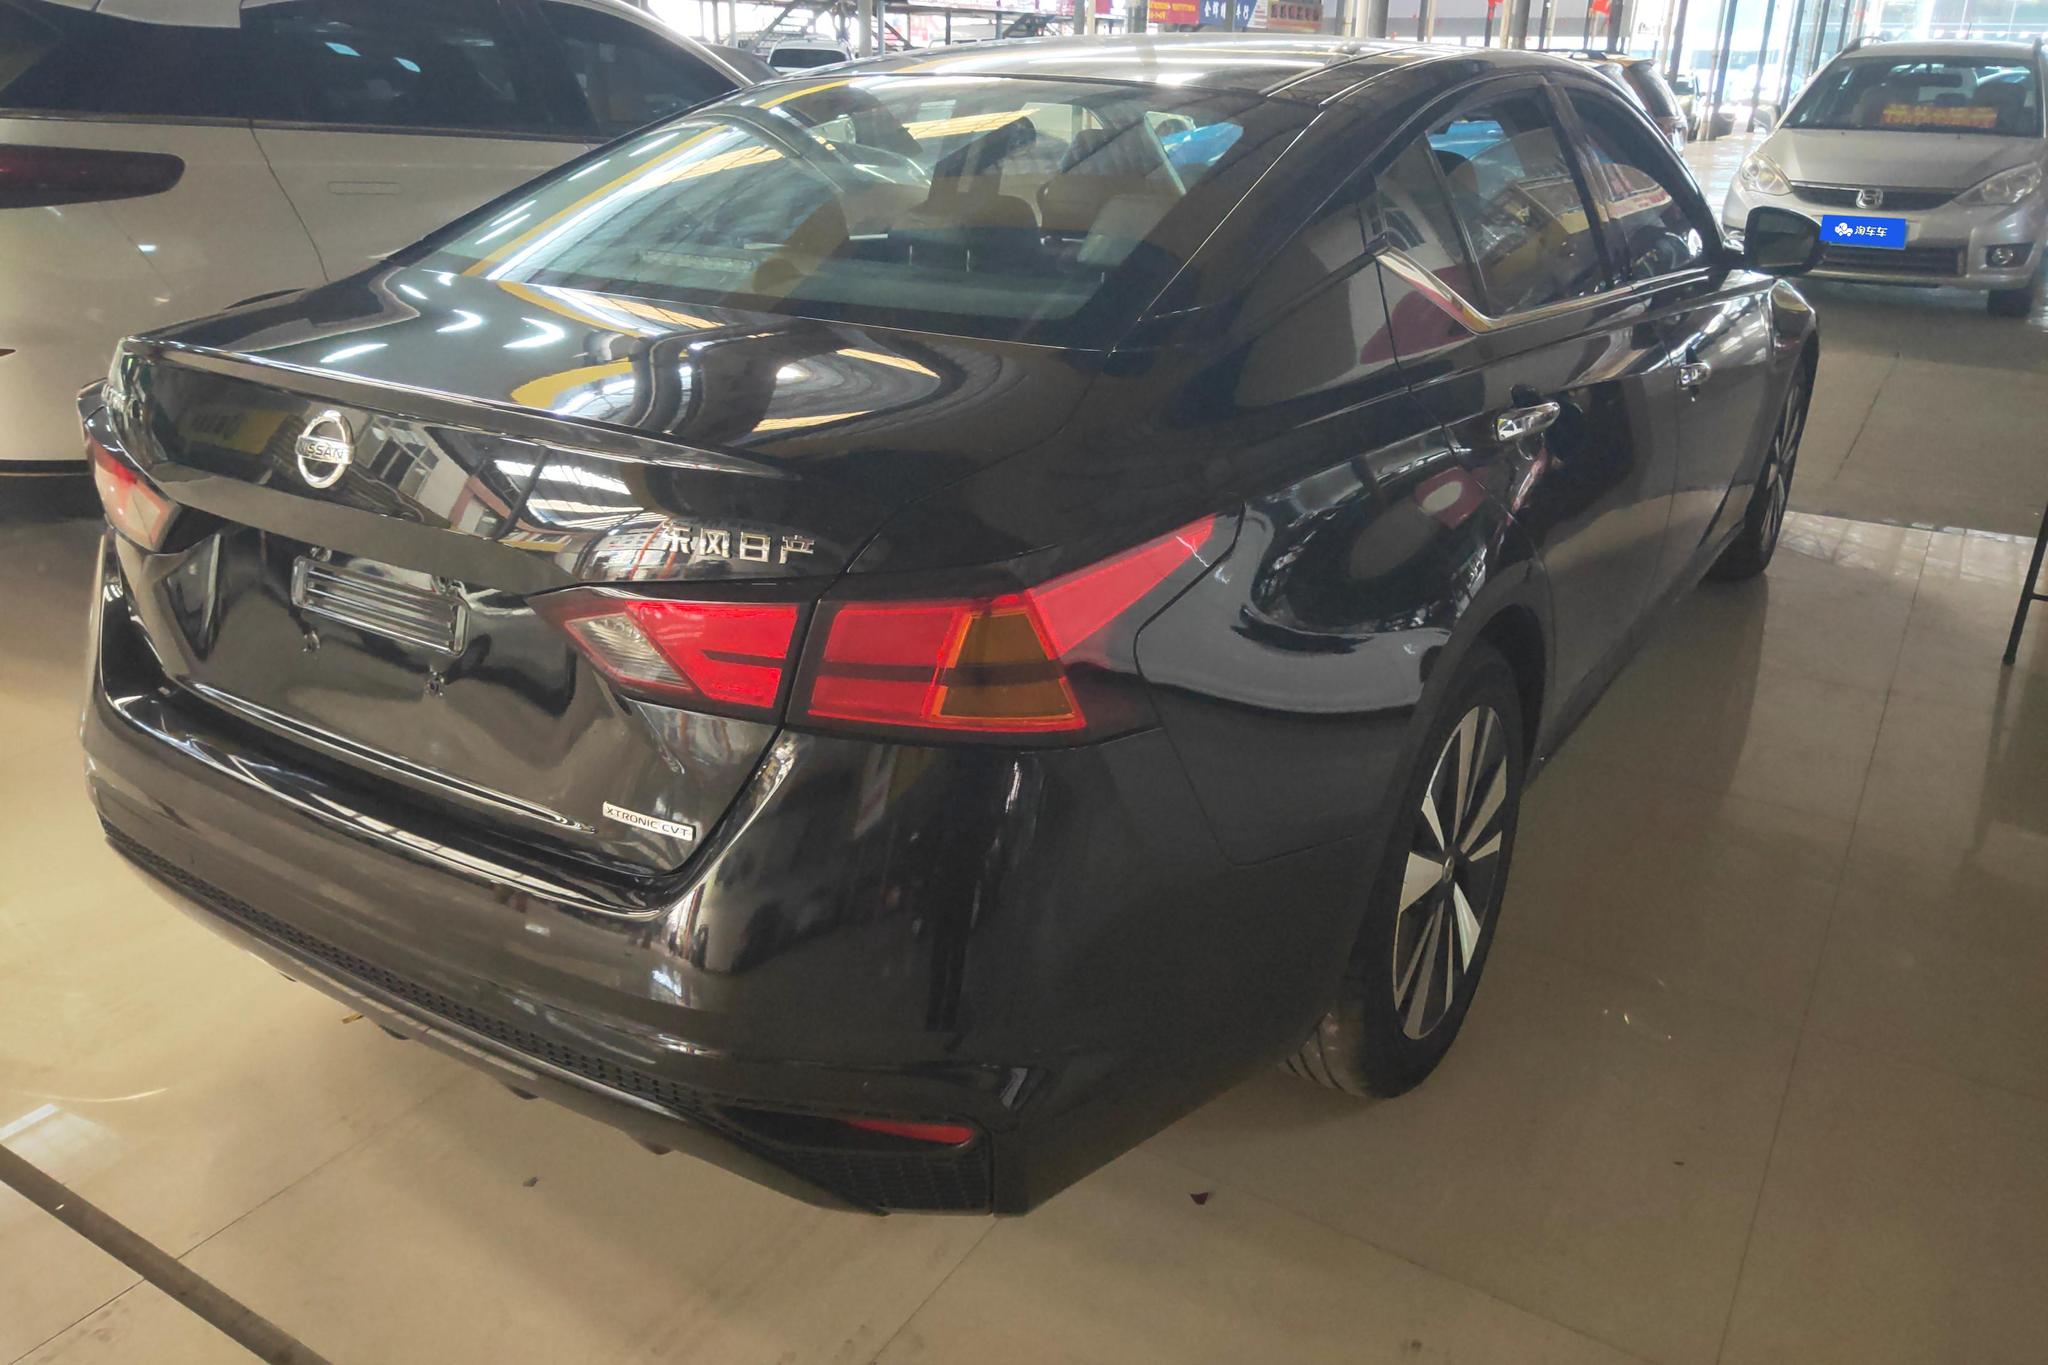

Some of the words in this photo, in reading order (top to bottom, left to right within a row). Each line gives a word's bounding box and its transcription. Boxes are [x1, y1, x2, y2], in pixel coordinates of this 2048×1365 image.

[662, 521, 814, 564] 东风日产
[606, 806, 658, 829] XTRONIC
[661, 823, 688, 837] CVT
